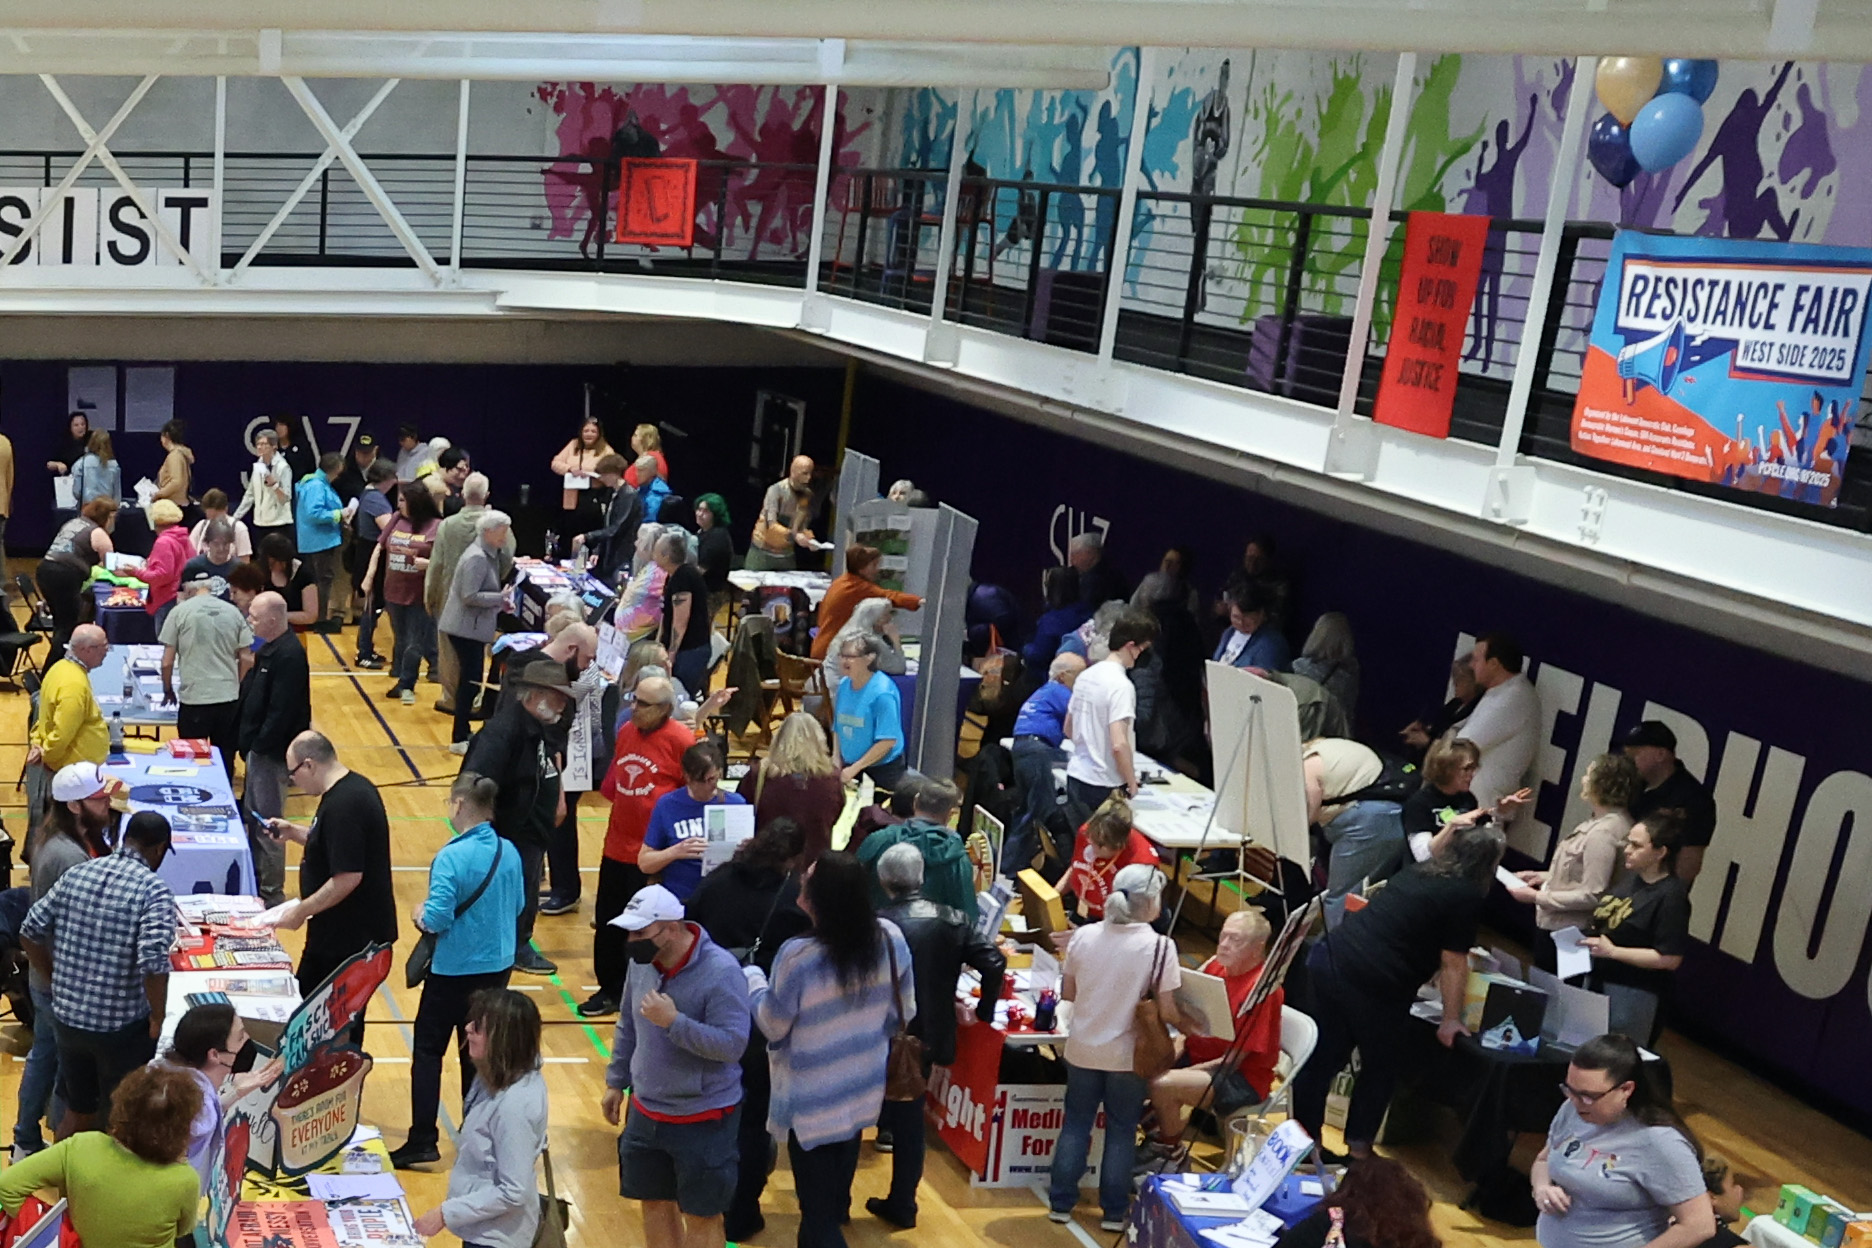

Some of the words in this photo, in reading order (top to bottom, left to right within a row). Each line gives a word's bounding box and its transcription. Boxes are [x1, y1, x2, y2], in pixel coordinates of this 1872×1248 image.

[1625, 274, 1784, 332] RESISTANCE
[1788, 284, 1859, 338] FAIR
[1741, 341, 1774, 365] WEST
[1777, 343, 1809, 367] SIDE
[1810, 348, 1847, 372] 2025
[291, 1104, 346, 1148] EVERYONE
[1022, 1135, 1055, 1156] For
[359, 1208, 389, 1240] PEOPLE
